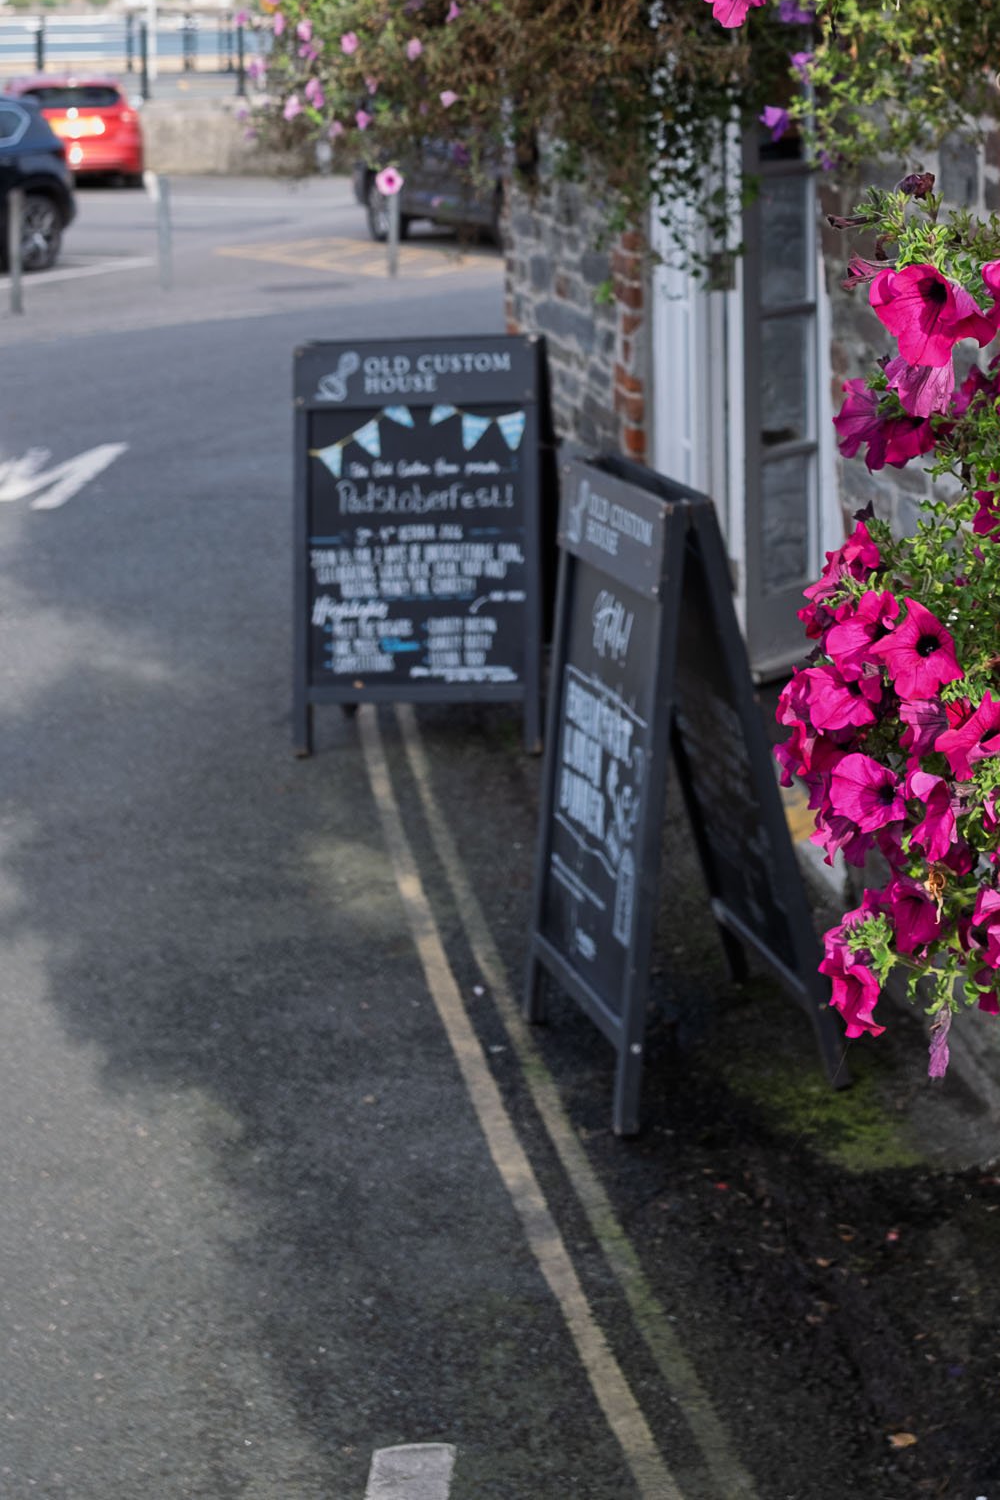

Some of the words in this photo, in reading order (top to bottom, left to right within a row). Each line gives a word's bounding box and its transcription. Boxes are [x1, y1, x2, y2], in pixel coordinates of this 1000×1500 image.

[363, 354, 411, 376] OLD
[416, 351, 511, 375] CUSTOM
[364, 373, 439, 395] HOUSE
[610, 503, 653, 548] CUSTOM
